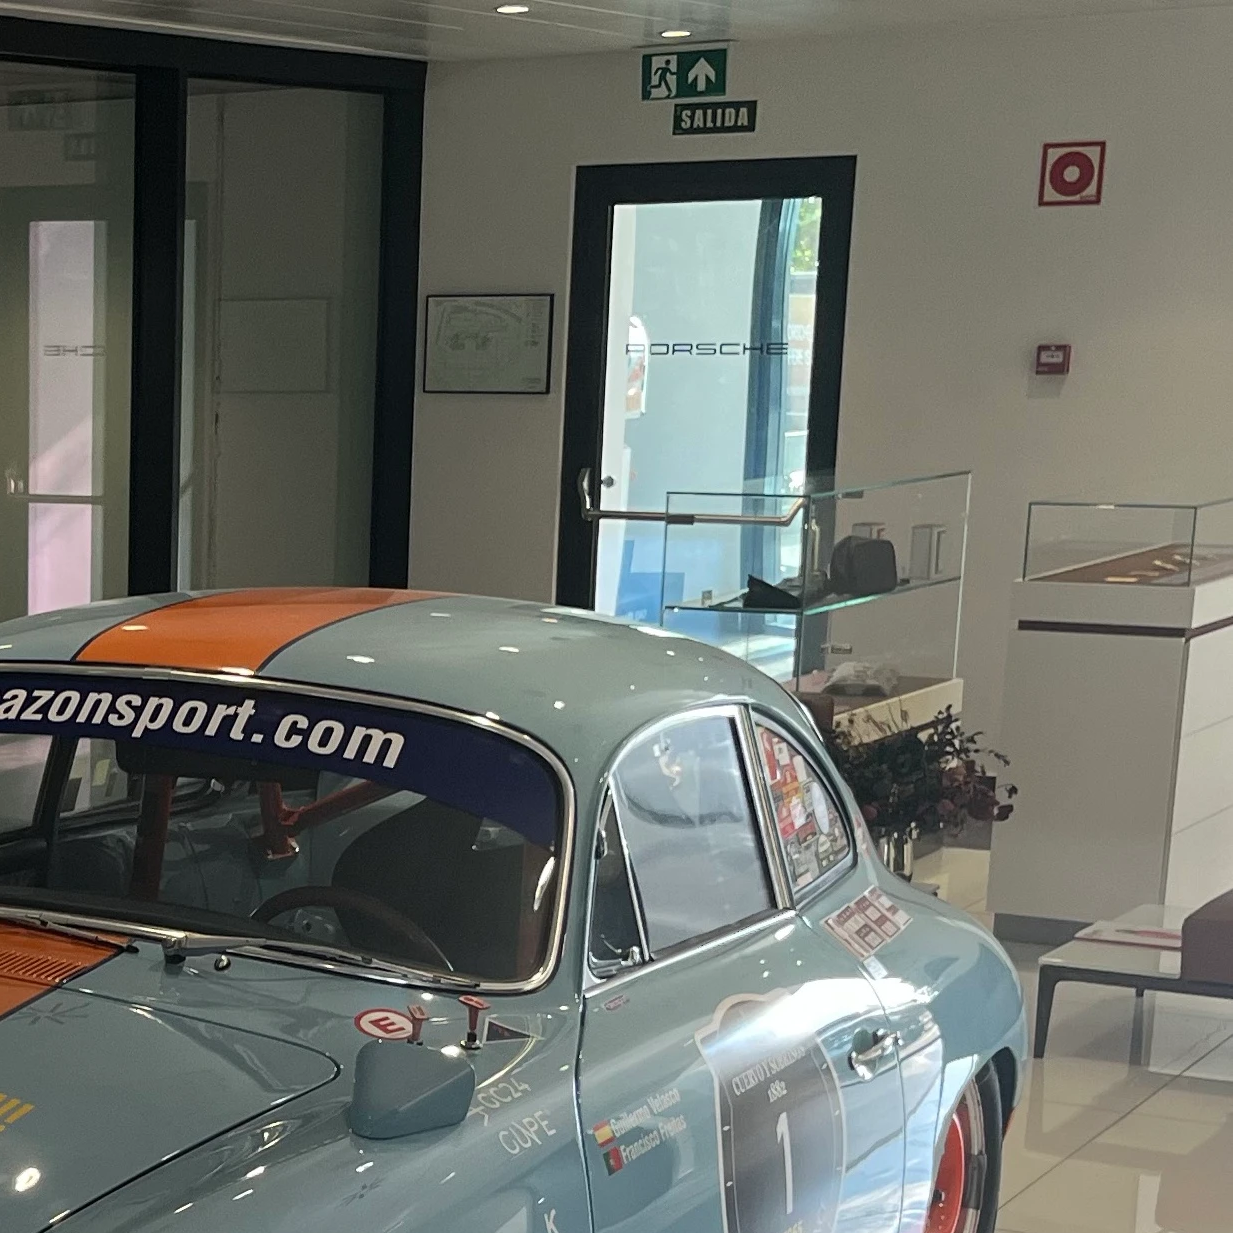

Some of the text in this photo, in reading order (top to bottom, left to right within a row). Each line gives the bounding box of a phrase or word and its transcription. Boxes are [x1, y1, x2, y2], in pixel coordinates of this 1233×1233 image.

[680, 107, 749, 129] SALIDA
[625, 342, 789, 356] PORSCHE
[367, 1016, 406, 1035] E
[775, 1111, 794, 1215] 1
